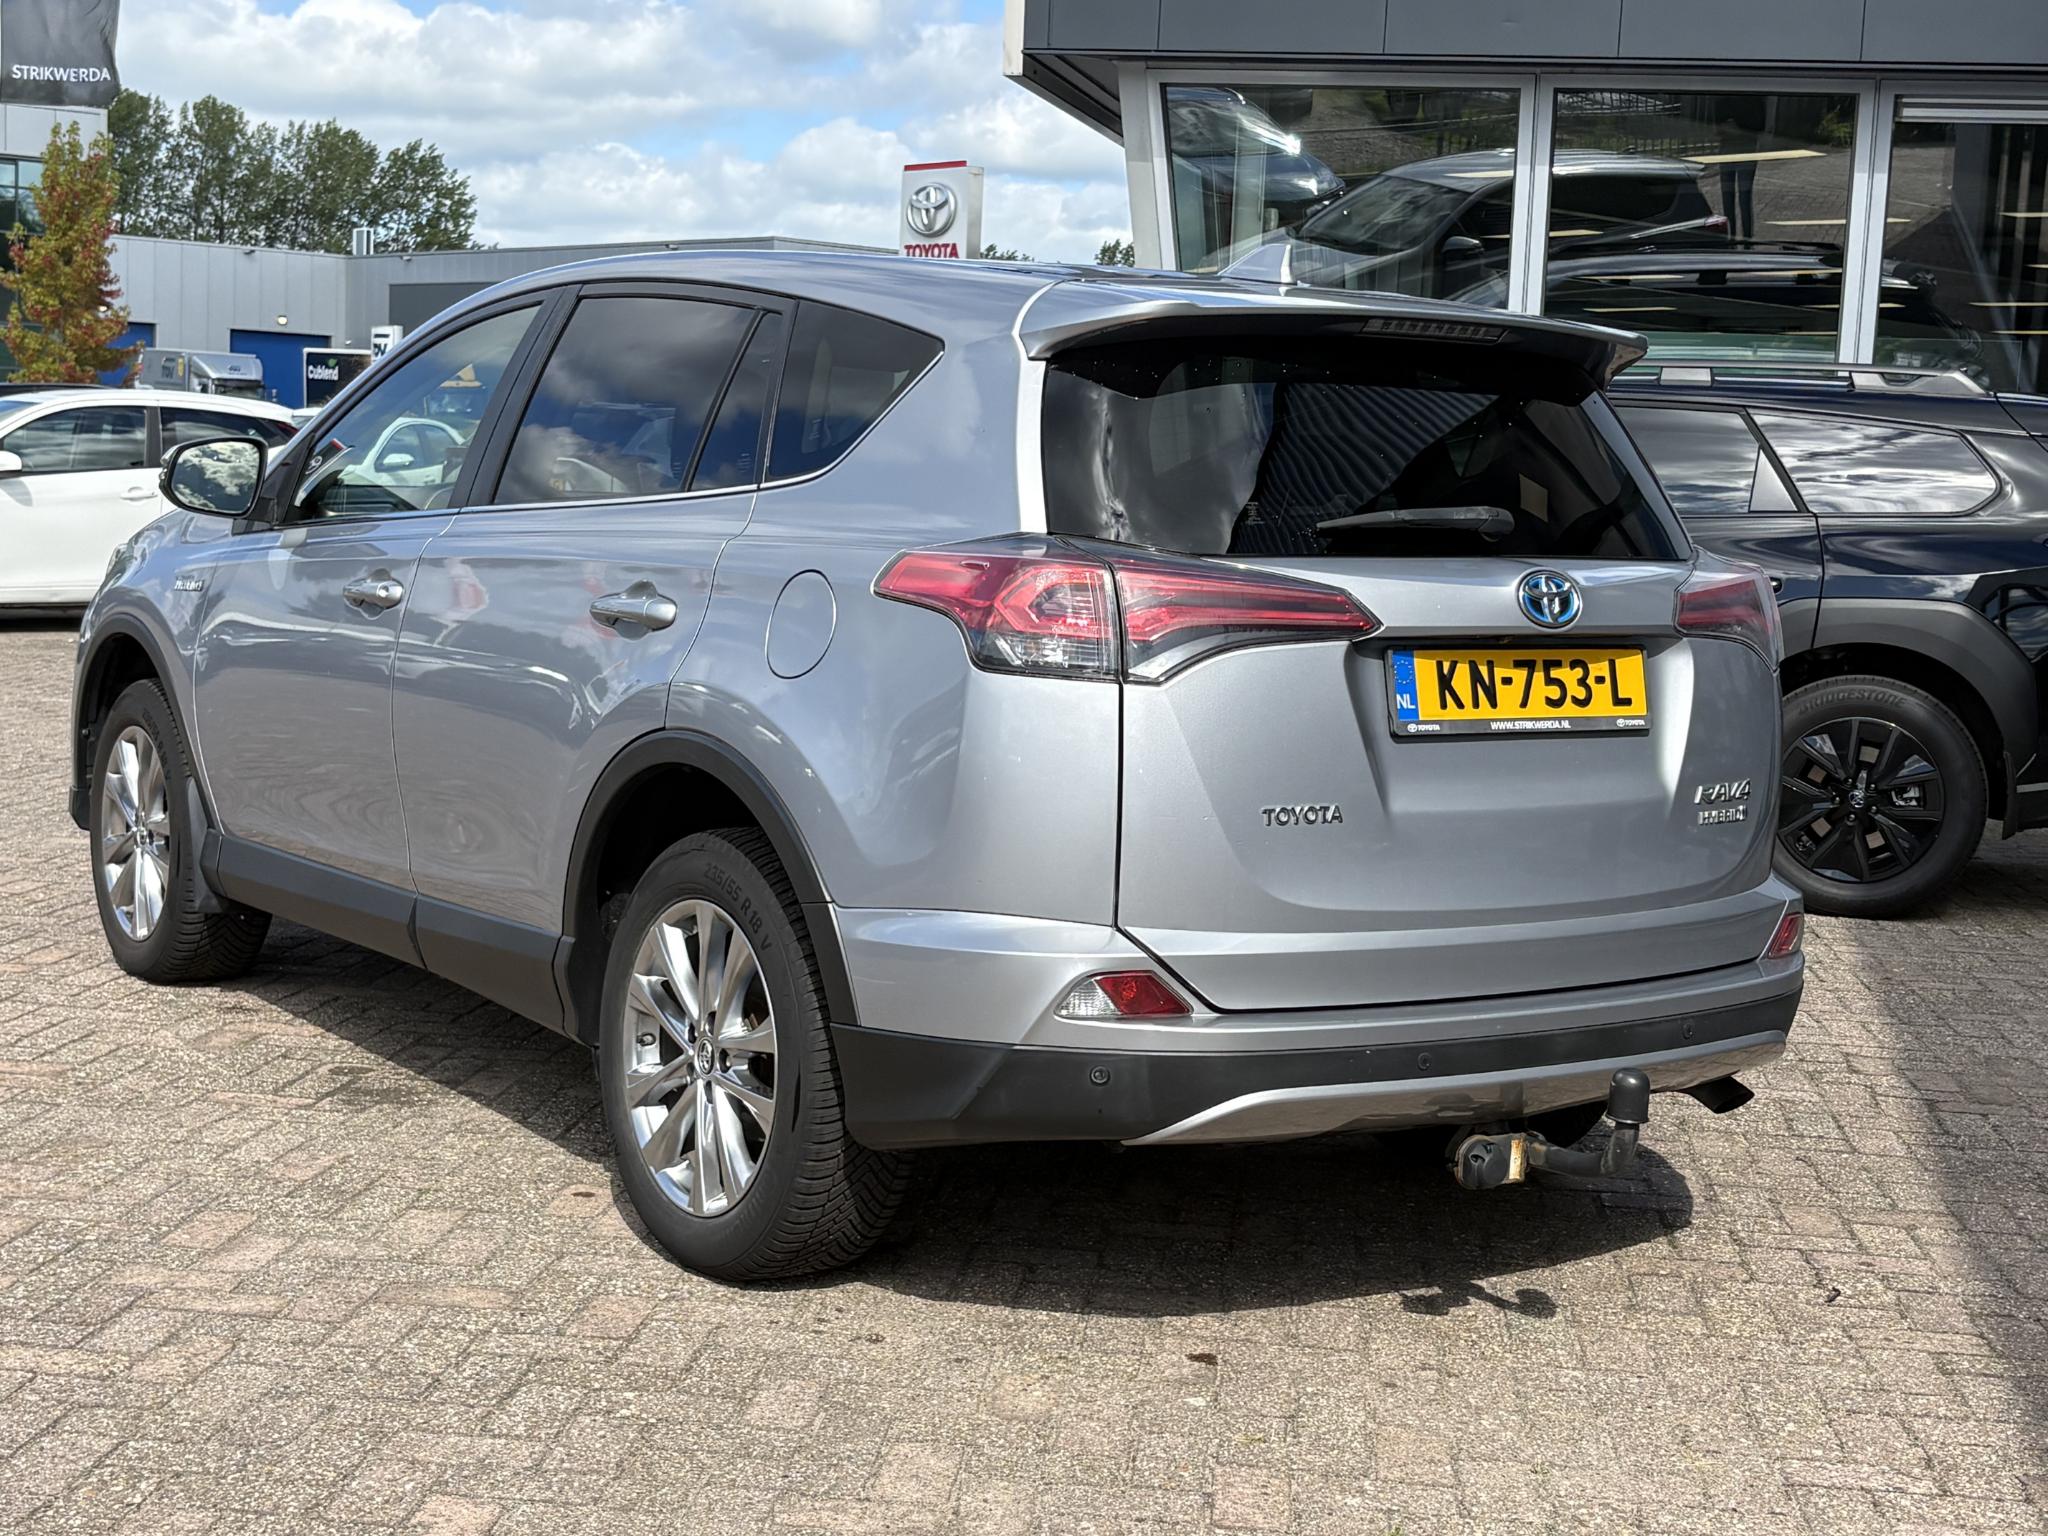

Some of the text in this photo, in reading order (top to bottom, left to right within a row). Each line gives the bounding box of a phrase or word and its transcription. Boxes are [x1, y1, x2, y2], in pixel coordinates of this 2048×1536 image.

[11, 64, 111, 82] STRIKWERDA
[904, 243, 959, 259] TOYOTA
[1435, 658, 1633, 710] KN-753-L
[1396, 694, 1416, 709] NL
[1693, 778, 1751, 804] RAV4
[1261, 804, 1344, 827] TOYOTA
